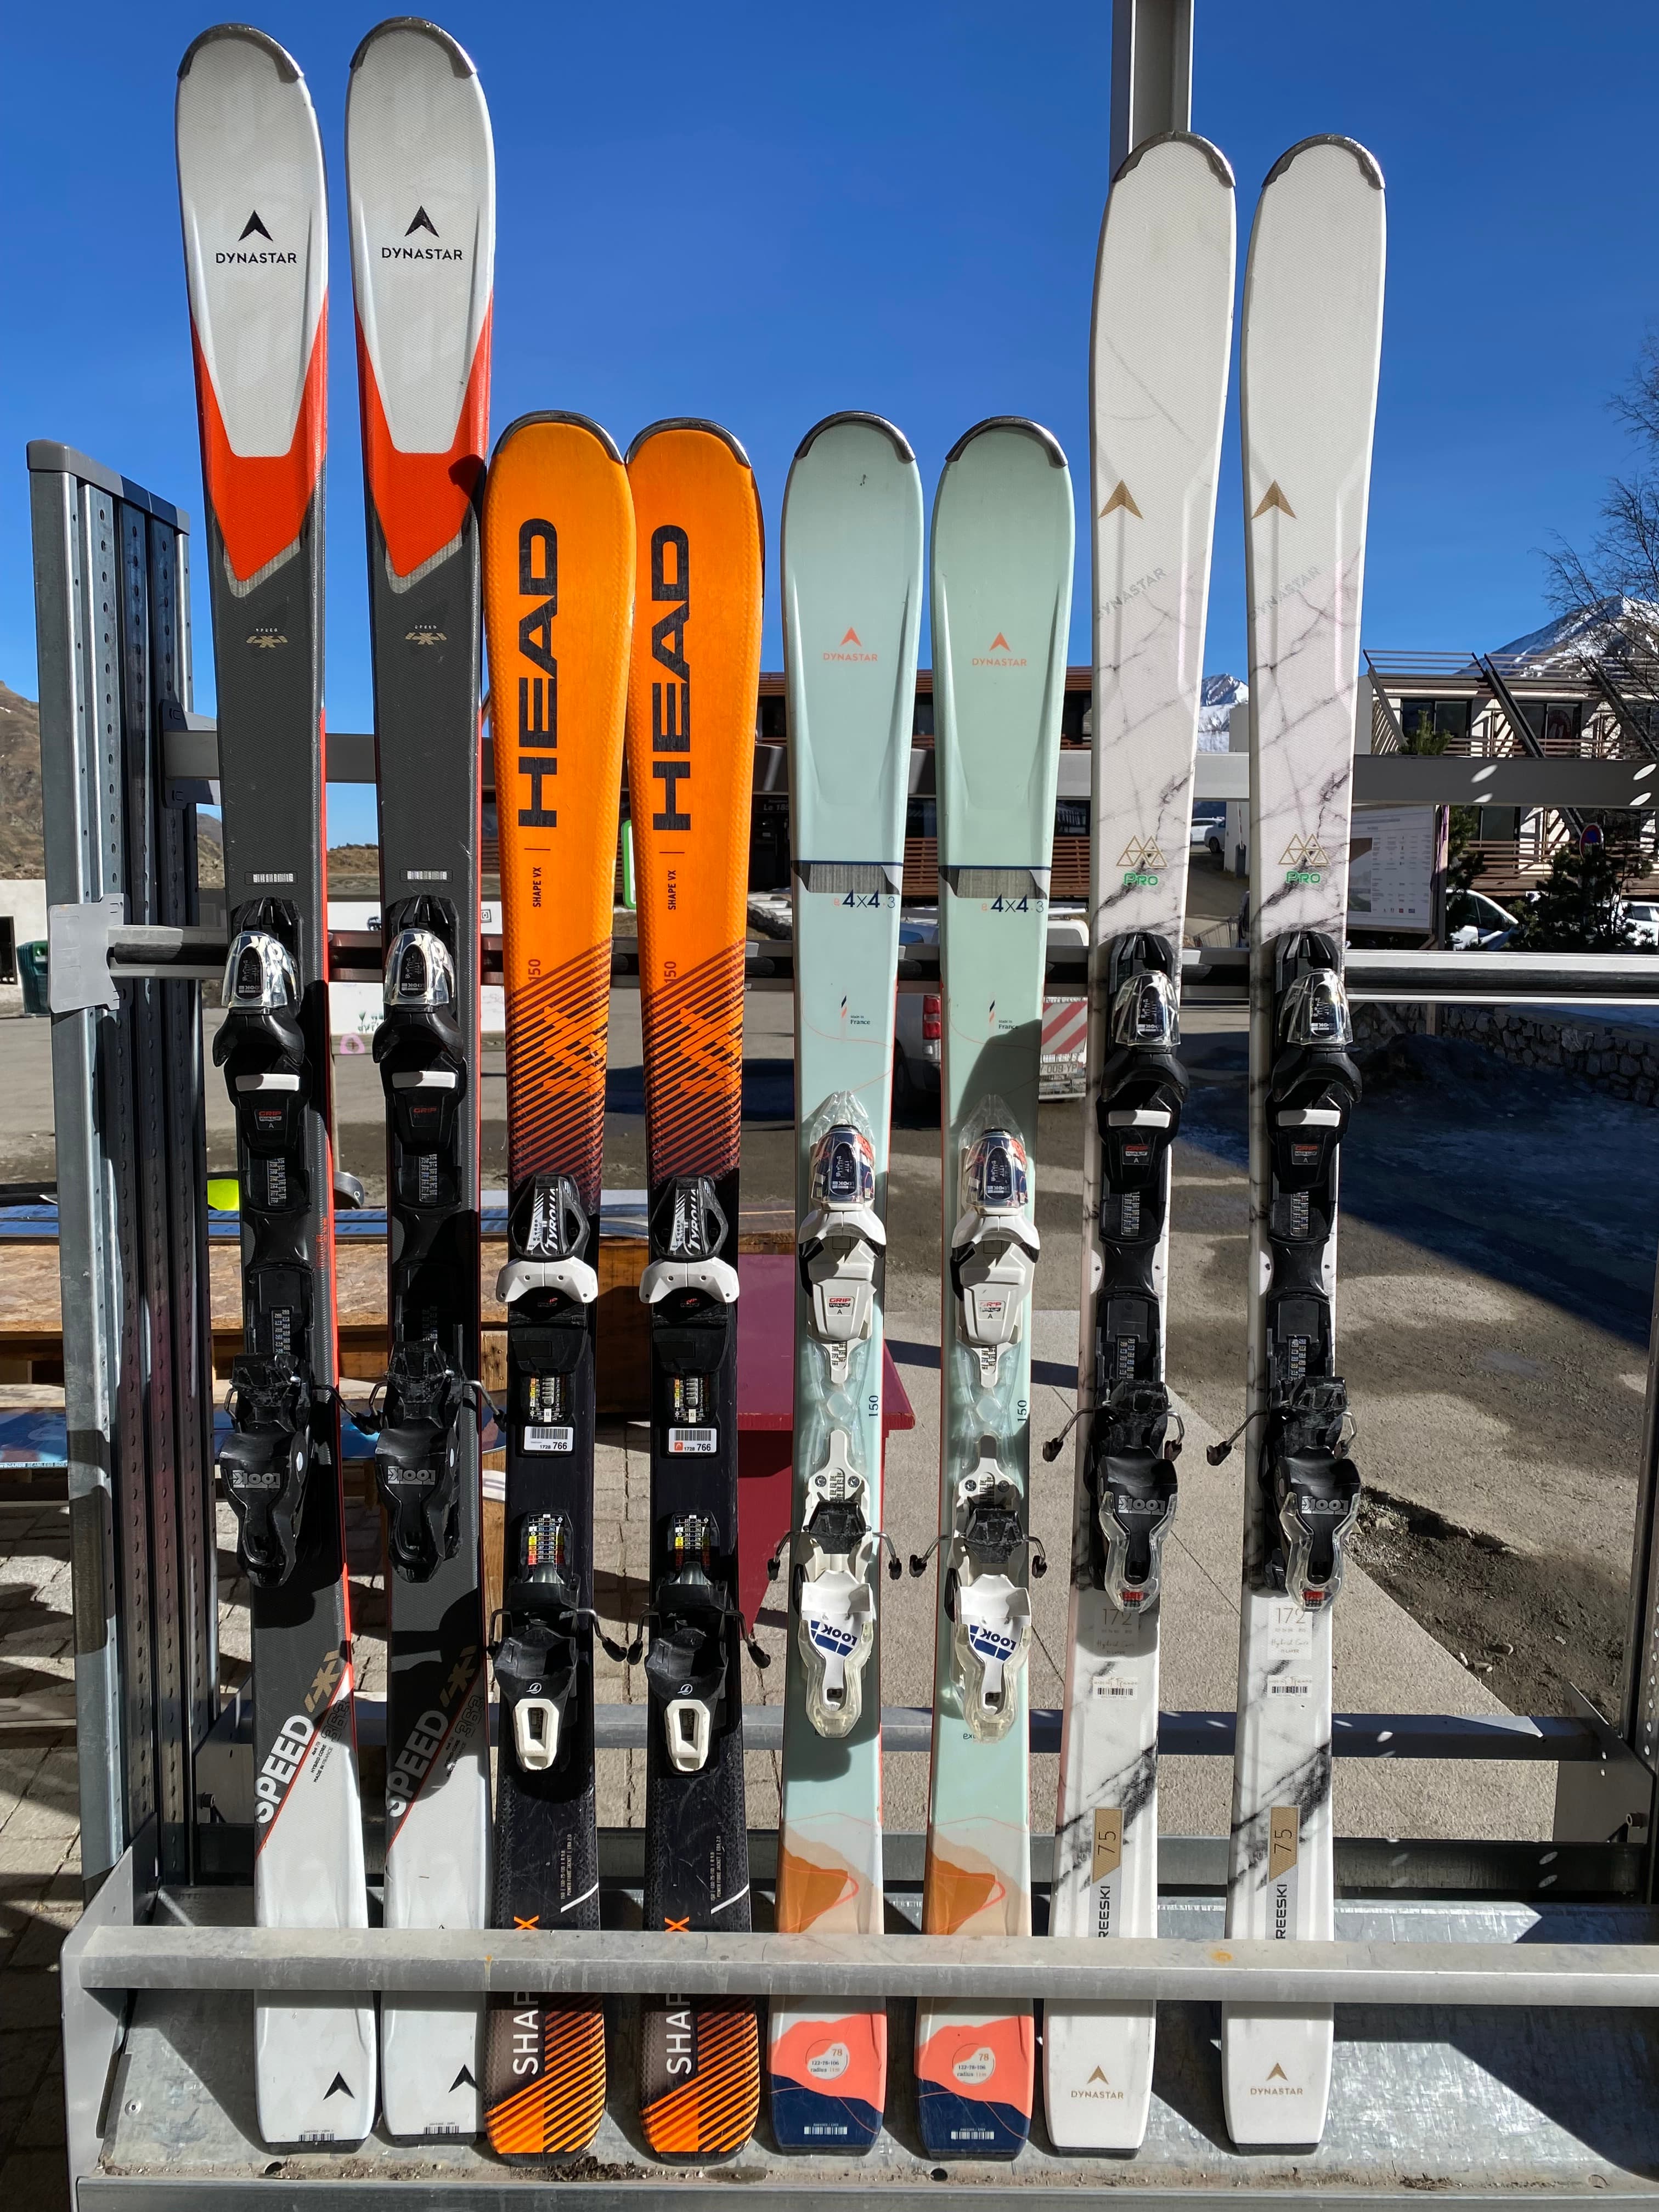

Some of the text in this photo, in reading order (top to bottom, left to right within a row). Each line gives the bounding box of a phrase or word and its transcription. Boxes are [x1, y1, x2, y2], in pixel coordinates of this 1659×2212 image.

[215, 252, 297, 264] DYNASTAR
[382, 247, 463, 261] DYNASTAR
[823, 652, 878, 662] DYNASTAR
[972, 658, 1027, 667] DYNASTAR
[518, 518, 557, 828] HEAD
[651, 524, 691, 831] HEAD
[532, 867, 542, 907] SHAPE VX
[668, 870, 677, 911] SHAPE VX
[528, 959, 541, 982] 150
[664, 961, 677, 984] 150
[868, 1395, 879, 1418] 150
[1017, 1400, 1028, 1423] 150
[232, 1470, 281, 1488] LOOK
[387, 1466, 436, 1485] LOOK
[1118, 1495, 1165, 1514] LOOK
[1301, 1495, 1348, 1514] LOOK
[823, 1626, 857, 1647] LOOK
[980, 1630, 1017, 1650] LOOK
[321, 1700, 350, 1743] 363
[455, 1695, 485, 1738] 363
[256, 1715, 315, 1824] SPEED
[311, 1744, 327, 1774] HYBRID CORE
[313, 1769, 322, 1783] MADE
[323, 1746, 334, 1765] FRANCE
[387, 1710, 449, 1818] SPEED
[1097, 1830, 1117, 1856] 75
[1273, 1828, 1293, 1854] 75
[1098, 1885, 1111, 1938] REESKI
[1276, 1884, 1288, 1939] REESKI
[513, 1992, 539, 2075] SHAP
[666, 1993, 691, 2075] SHAP
[1070, 2090, 1124, 2100] DYNASTAR
[1250, 2087, 1304, 2096] DYNASTAR
